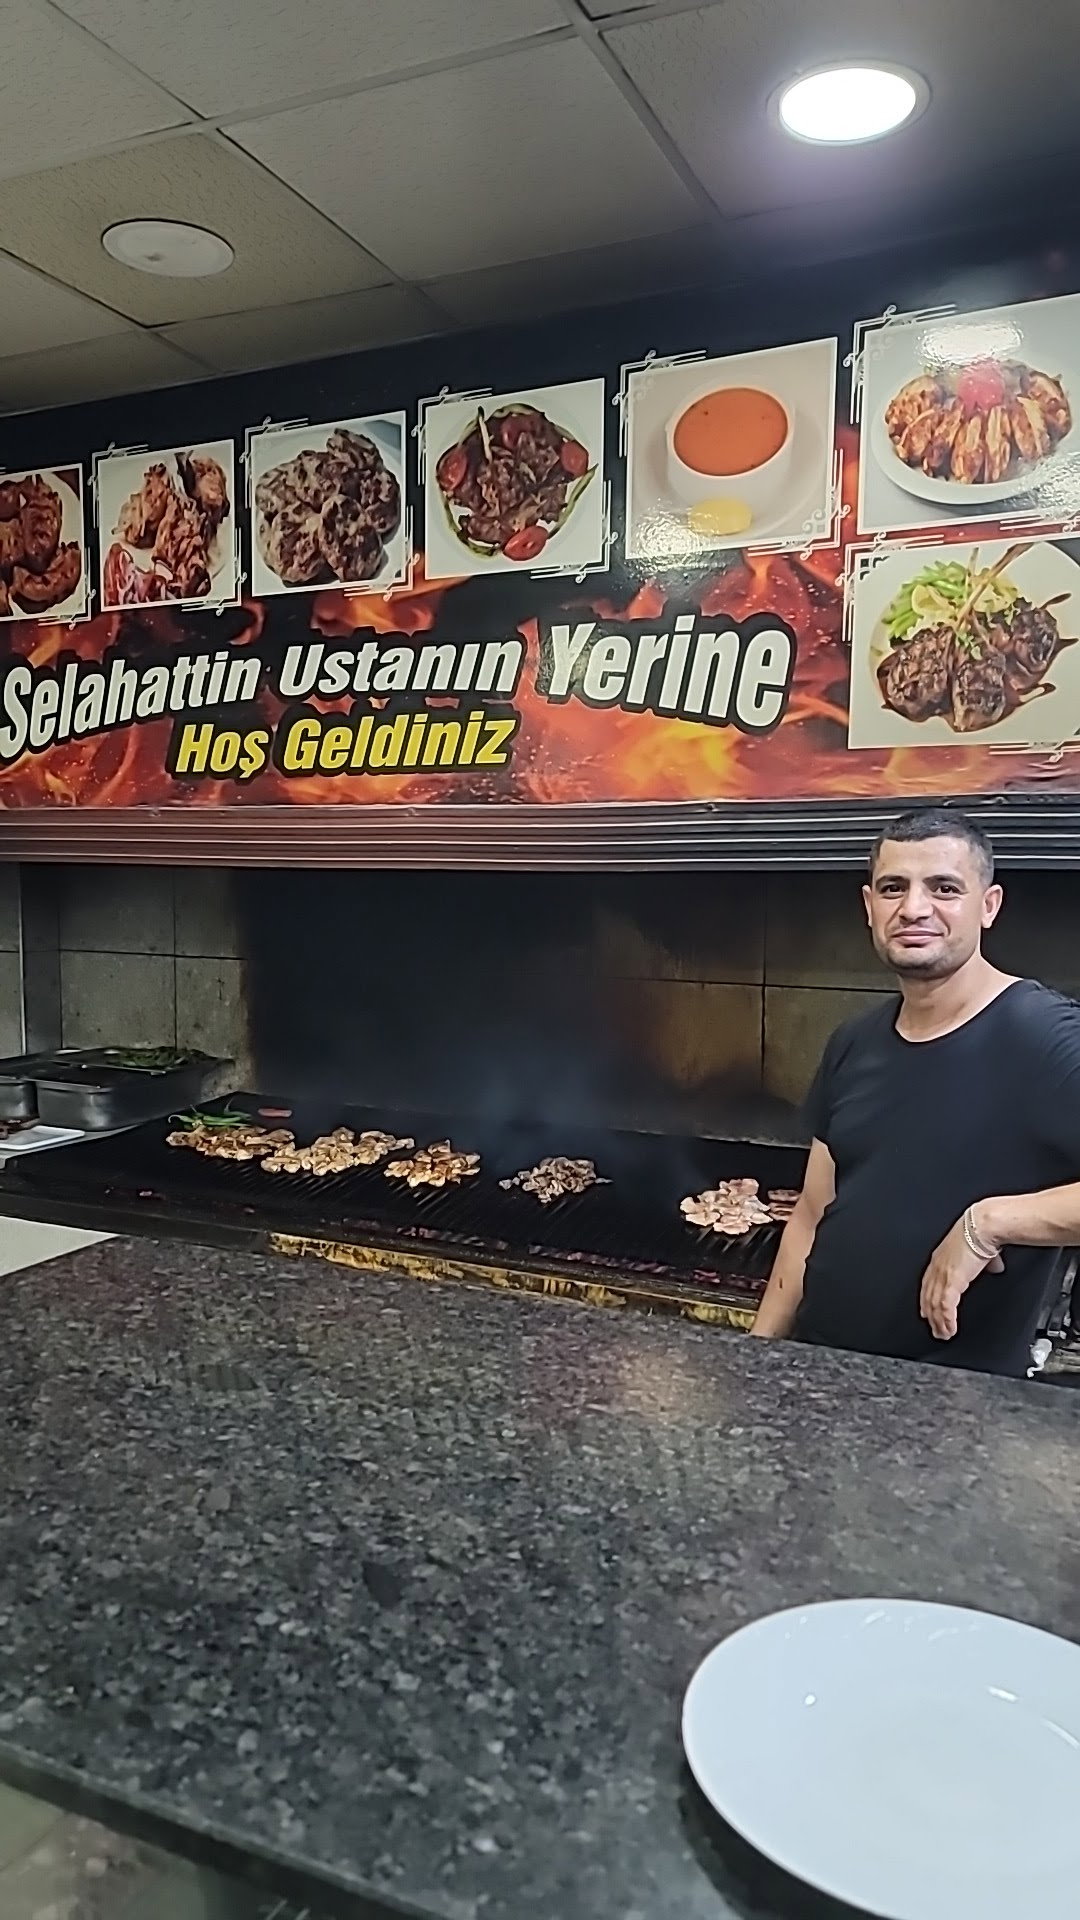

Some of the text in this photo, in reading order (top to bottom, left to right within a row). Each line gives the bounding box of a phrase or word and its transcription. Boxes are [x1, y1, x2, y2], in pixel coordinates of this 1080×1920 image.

[0, 614, 792, 758] Selahattin Ustanın Yerine
[175, 711, 517, 778] Hoş Geldiniz
